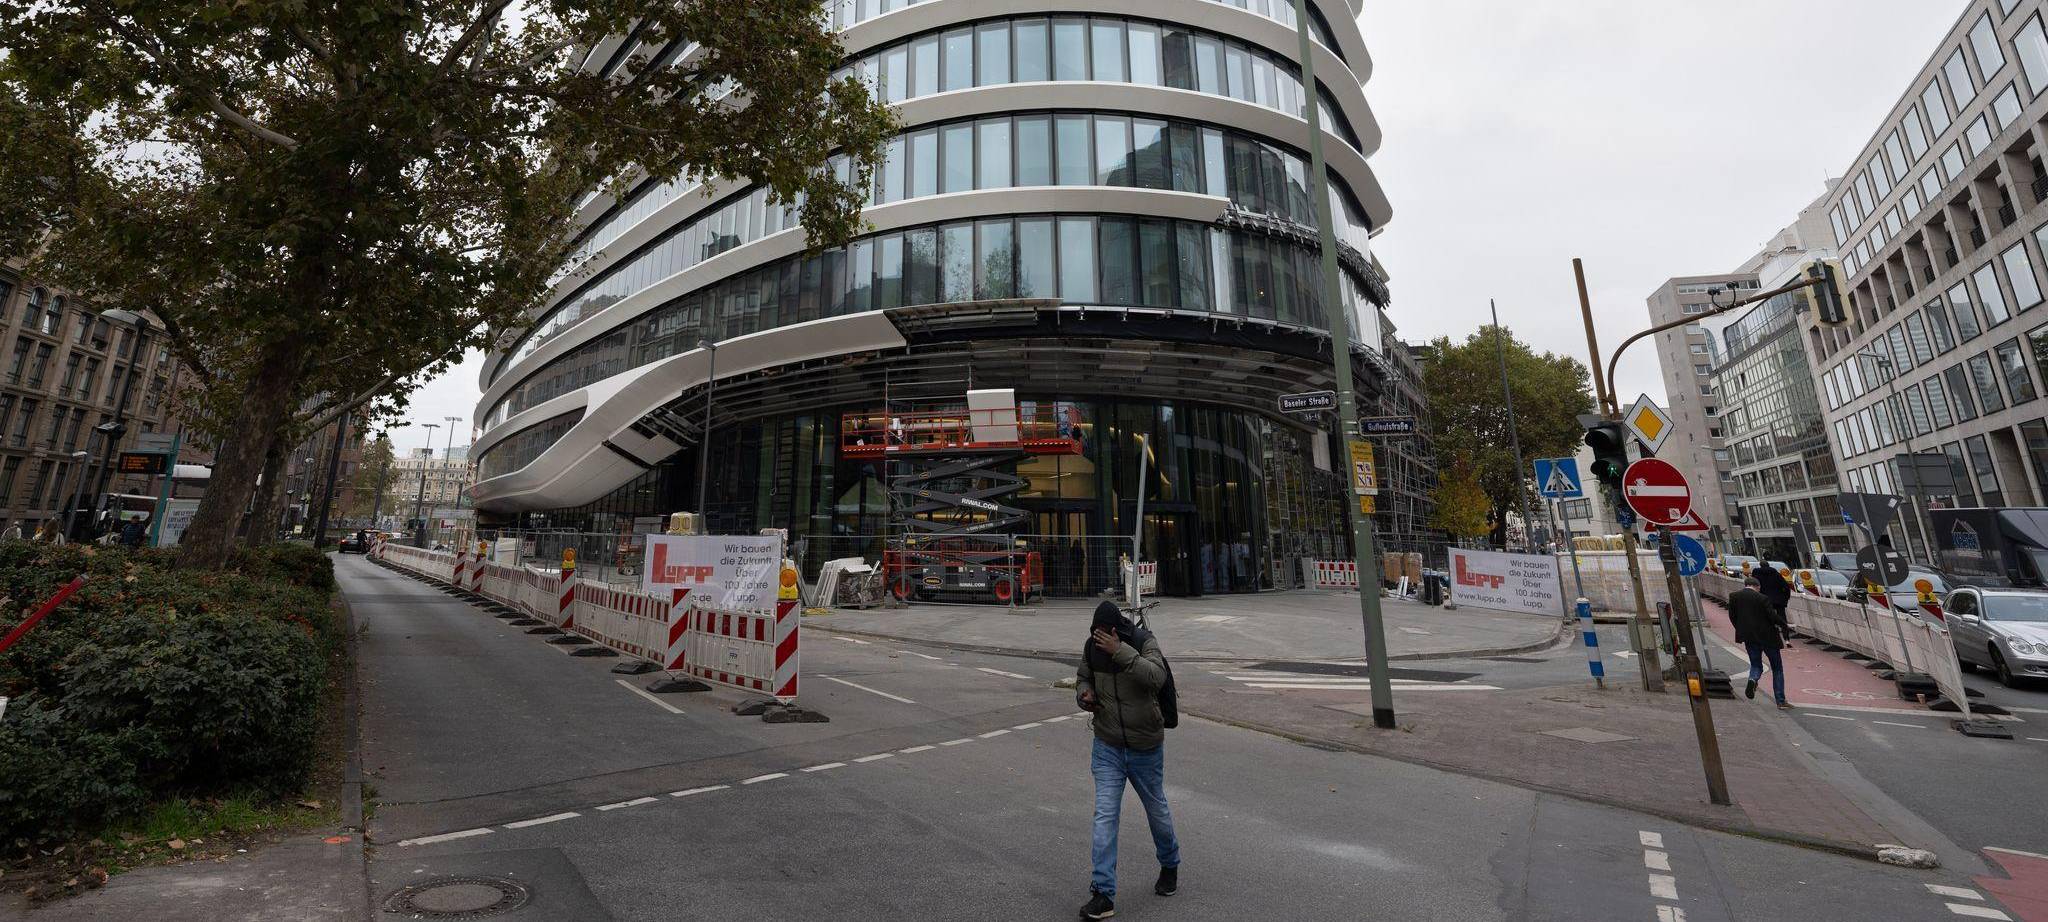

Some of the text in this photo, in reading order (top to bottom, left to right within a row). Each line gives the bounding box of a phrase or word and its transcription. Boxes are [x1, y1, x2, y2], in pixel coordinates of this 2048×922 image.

[1284, 396, 1329, 408] Baseler Straße
[961, 498, 999, 511] RIWAL.COM
[724, 544, 772, 553] Wir bauen
[720, 556, 735, 566] die
[1510, 559, 1550, 570] Wir bauen
[735, 566, 759, 578] Über
[1509, 569, 1521, 577] die
[725, 580, 769, 590] 100 Jahre
[1522, 578, 1541, 589] Über
[1457, 593, 1507, 604] www.lupp.de
[1515, 588, 1552, 599] 100 Jahre
